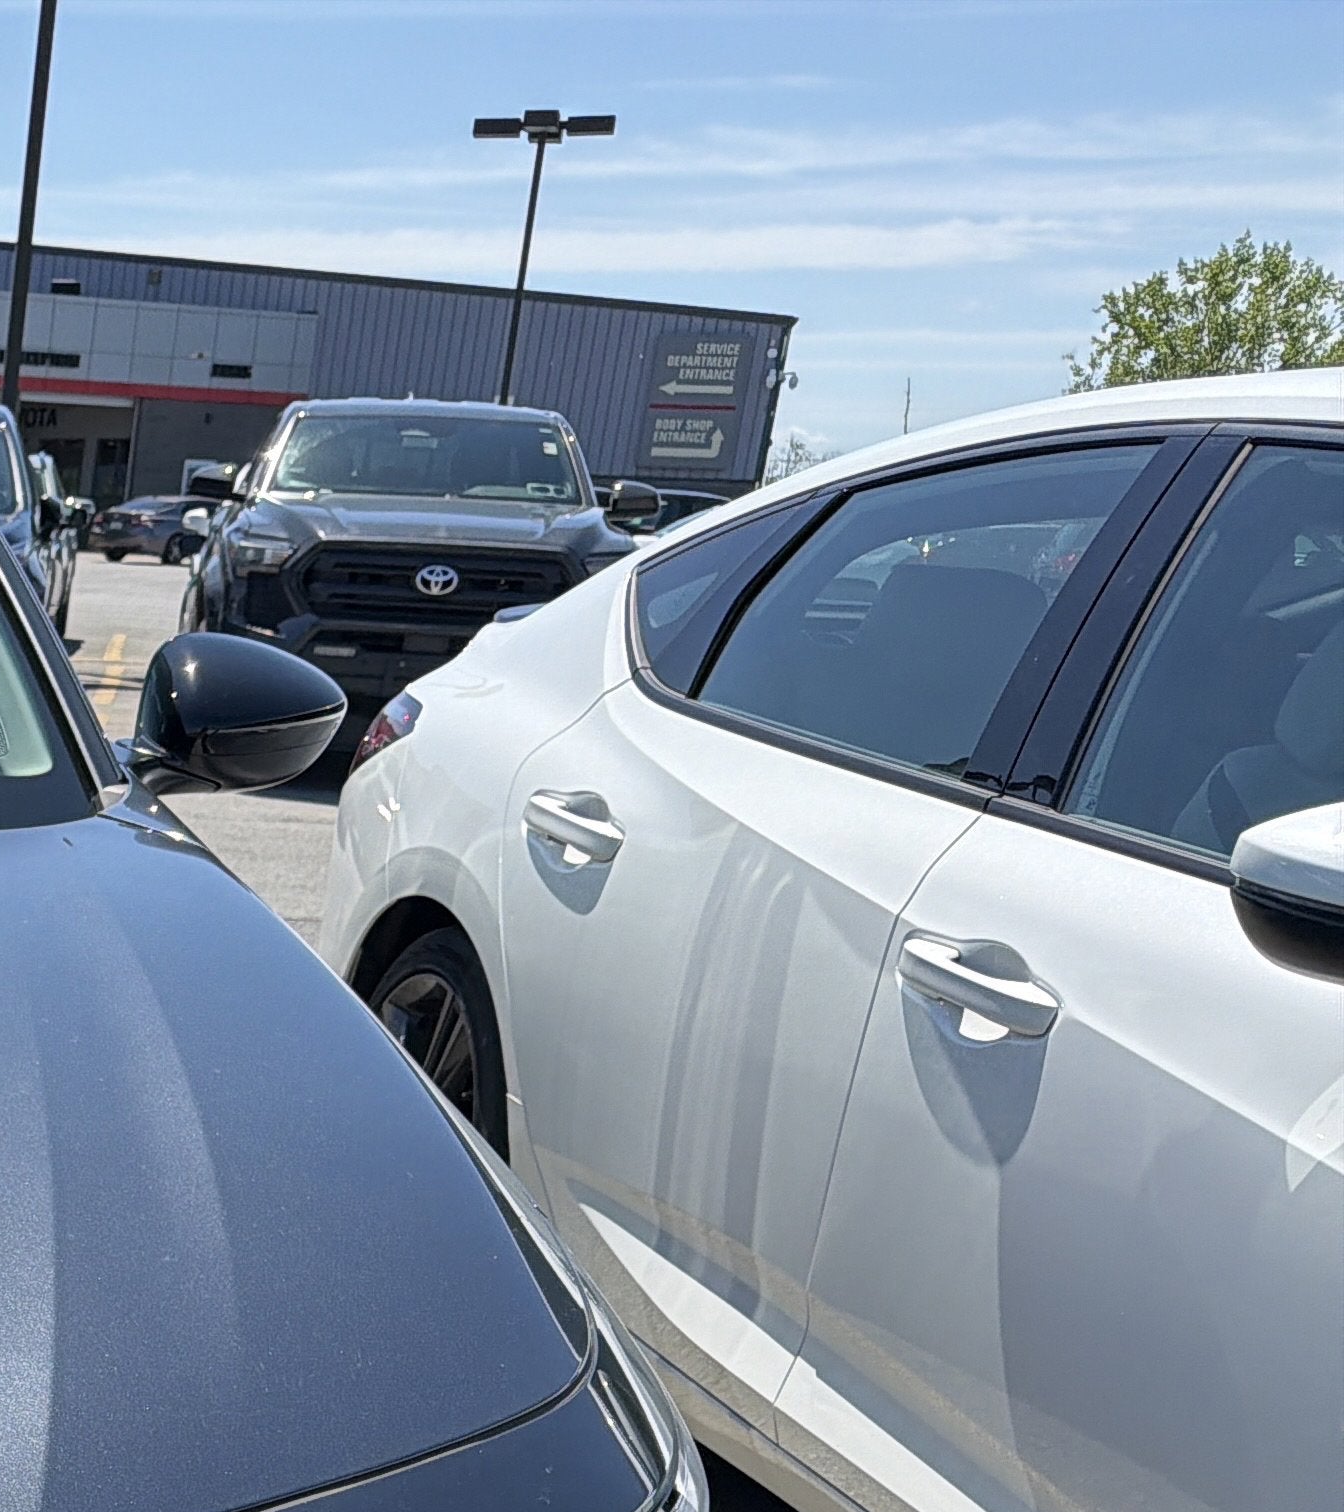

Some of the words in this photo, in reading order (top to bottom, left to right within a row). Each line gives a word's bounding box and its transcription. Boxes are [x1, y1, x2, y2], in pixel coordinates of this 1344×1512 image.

[696, 343, 741, 355] SERVICE
[667, 355, 738, 367] DEPARTMENT
[679, 368, 735, 380] ENTRANCE
[655, 419, 684, 430] BODY
[685, 420, 714, 431] SHOP
[653, 432, 707, 443] ENTRANCE
